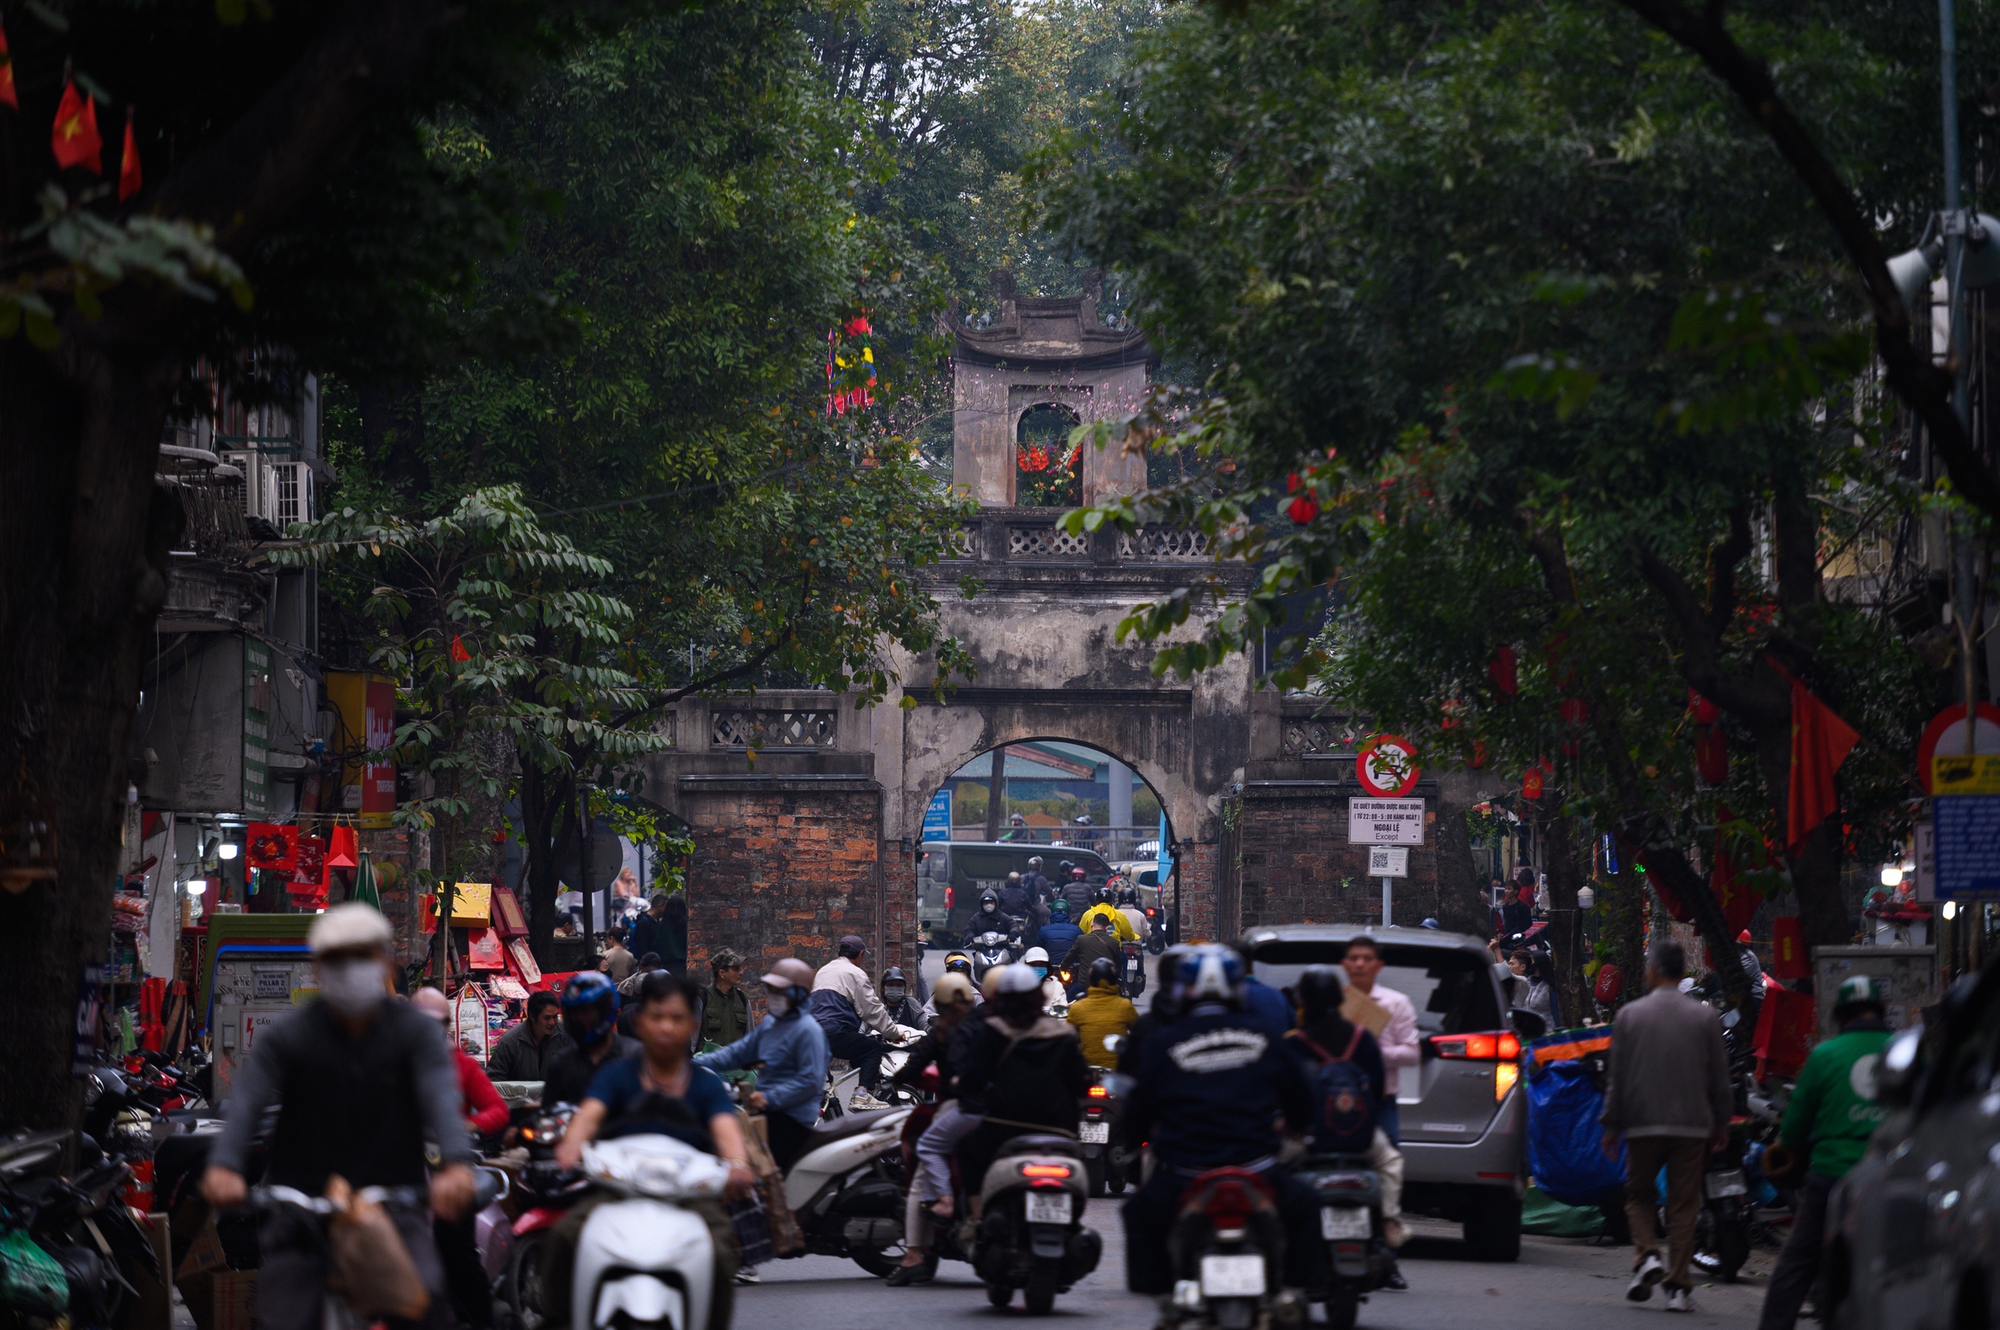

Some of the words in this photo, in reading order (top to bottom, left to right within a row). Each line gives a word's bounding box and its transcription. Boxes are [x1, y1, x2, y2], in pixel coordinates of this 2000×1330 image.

[1410, 803, 1422, 811] ĐỘNG
[1393, 812, 1404, 820] HÀNG
[1374, 823, 1392, 832] NGOẠI
[1393, 822, 1400, 833] LỆ
[1375, 833, 1399, 841] Except
[256, 1017, 271, 1025] CẤM
